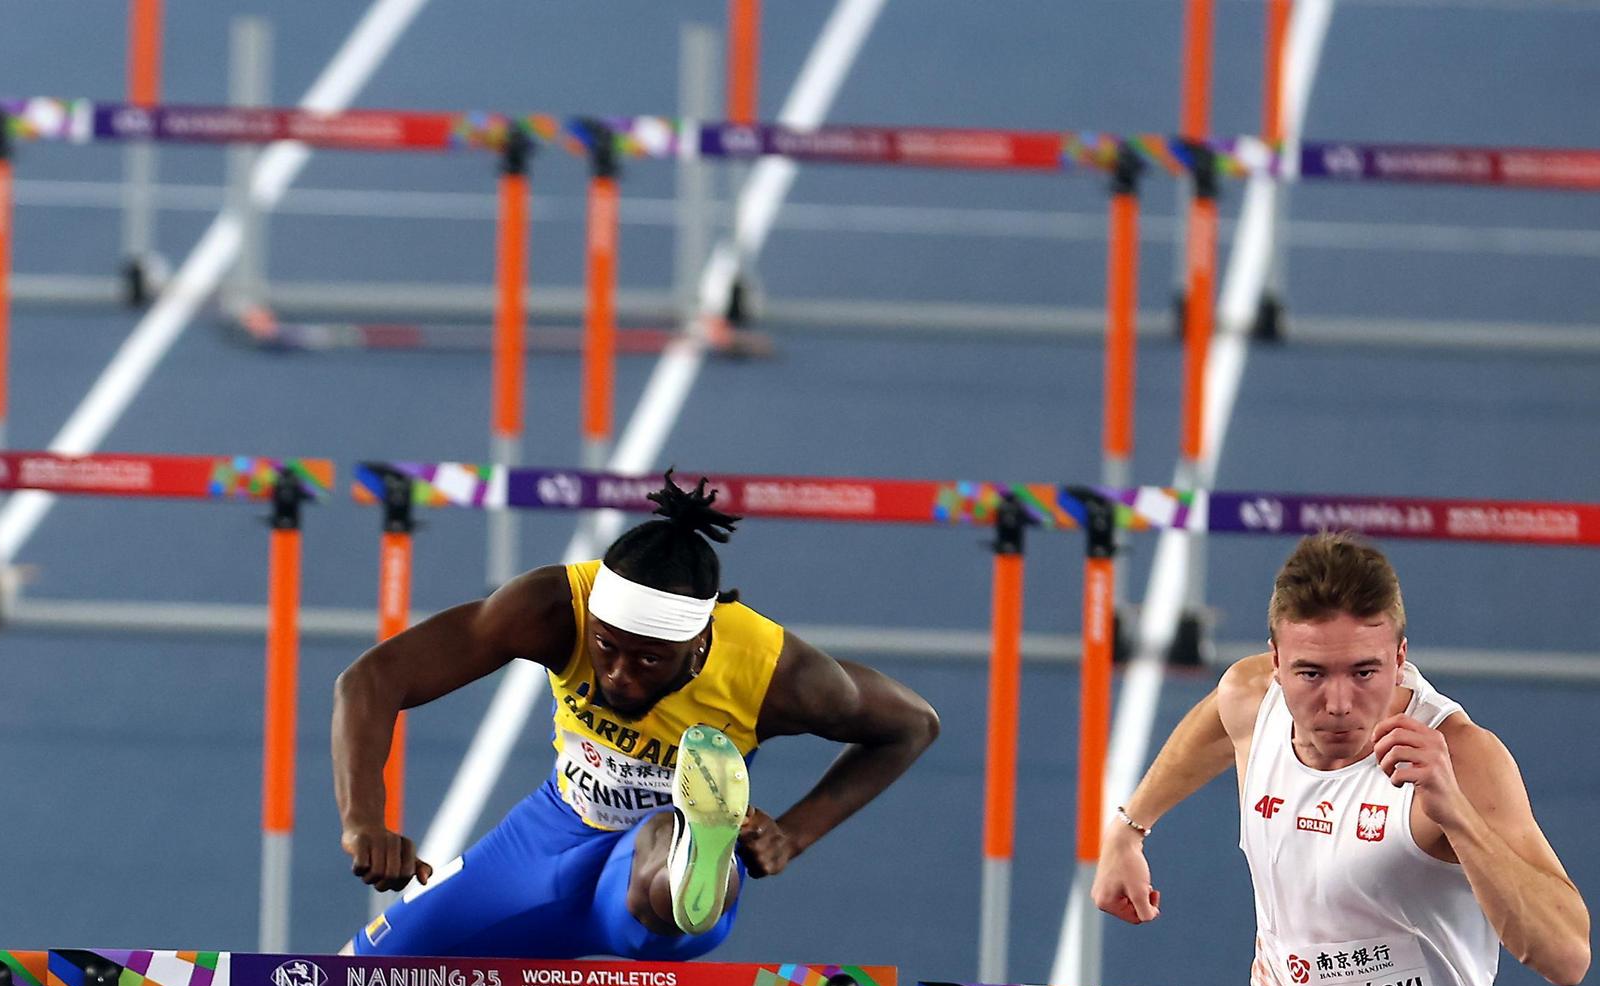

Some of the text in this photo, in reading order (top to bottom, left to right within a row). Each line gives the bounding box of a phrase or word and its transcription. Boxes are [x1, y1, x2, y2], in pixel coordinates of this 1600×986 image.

[1254, 795, 1285, 819] 4F
[1299, 818, 1331, 834] ORLEN
[1316, 944, 1391, 971] 南京银行
[522, 969, 583, 985] WORLD
[1320, 971, 1343, 980] BANK
[1358, 961, 1394, 975] NANJING
